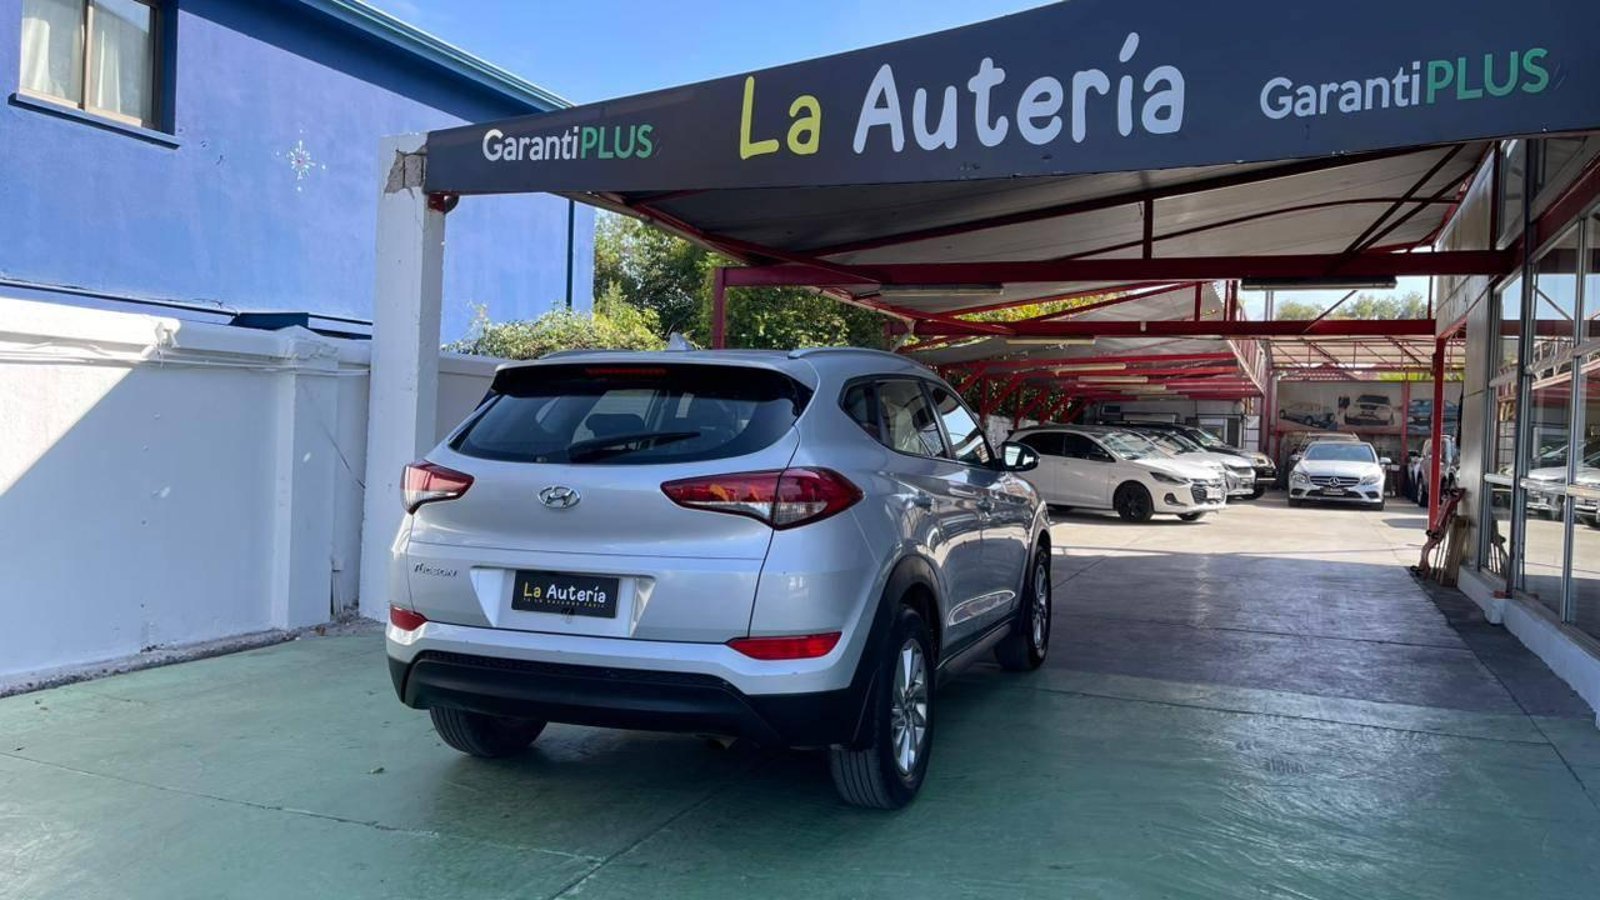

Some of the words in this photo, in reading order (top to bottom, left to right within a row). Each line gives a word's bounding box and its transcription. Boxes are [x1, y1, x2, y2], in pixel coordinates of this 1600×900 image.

[739, 75, 822, 160] La
[853, 31, 1185, 154] Autería
[1259, 47, 1549, 120] GarantiPLUS
[481, 124, 654, 162] GarantiPLUS
[523, 581, 542, 599] La
[546, 584, 607, 604] Autería
